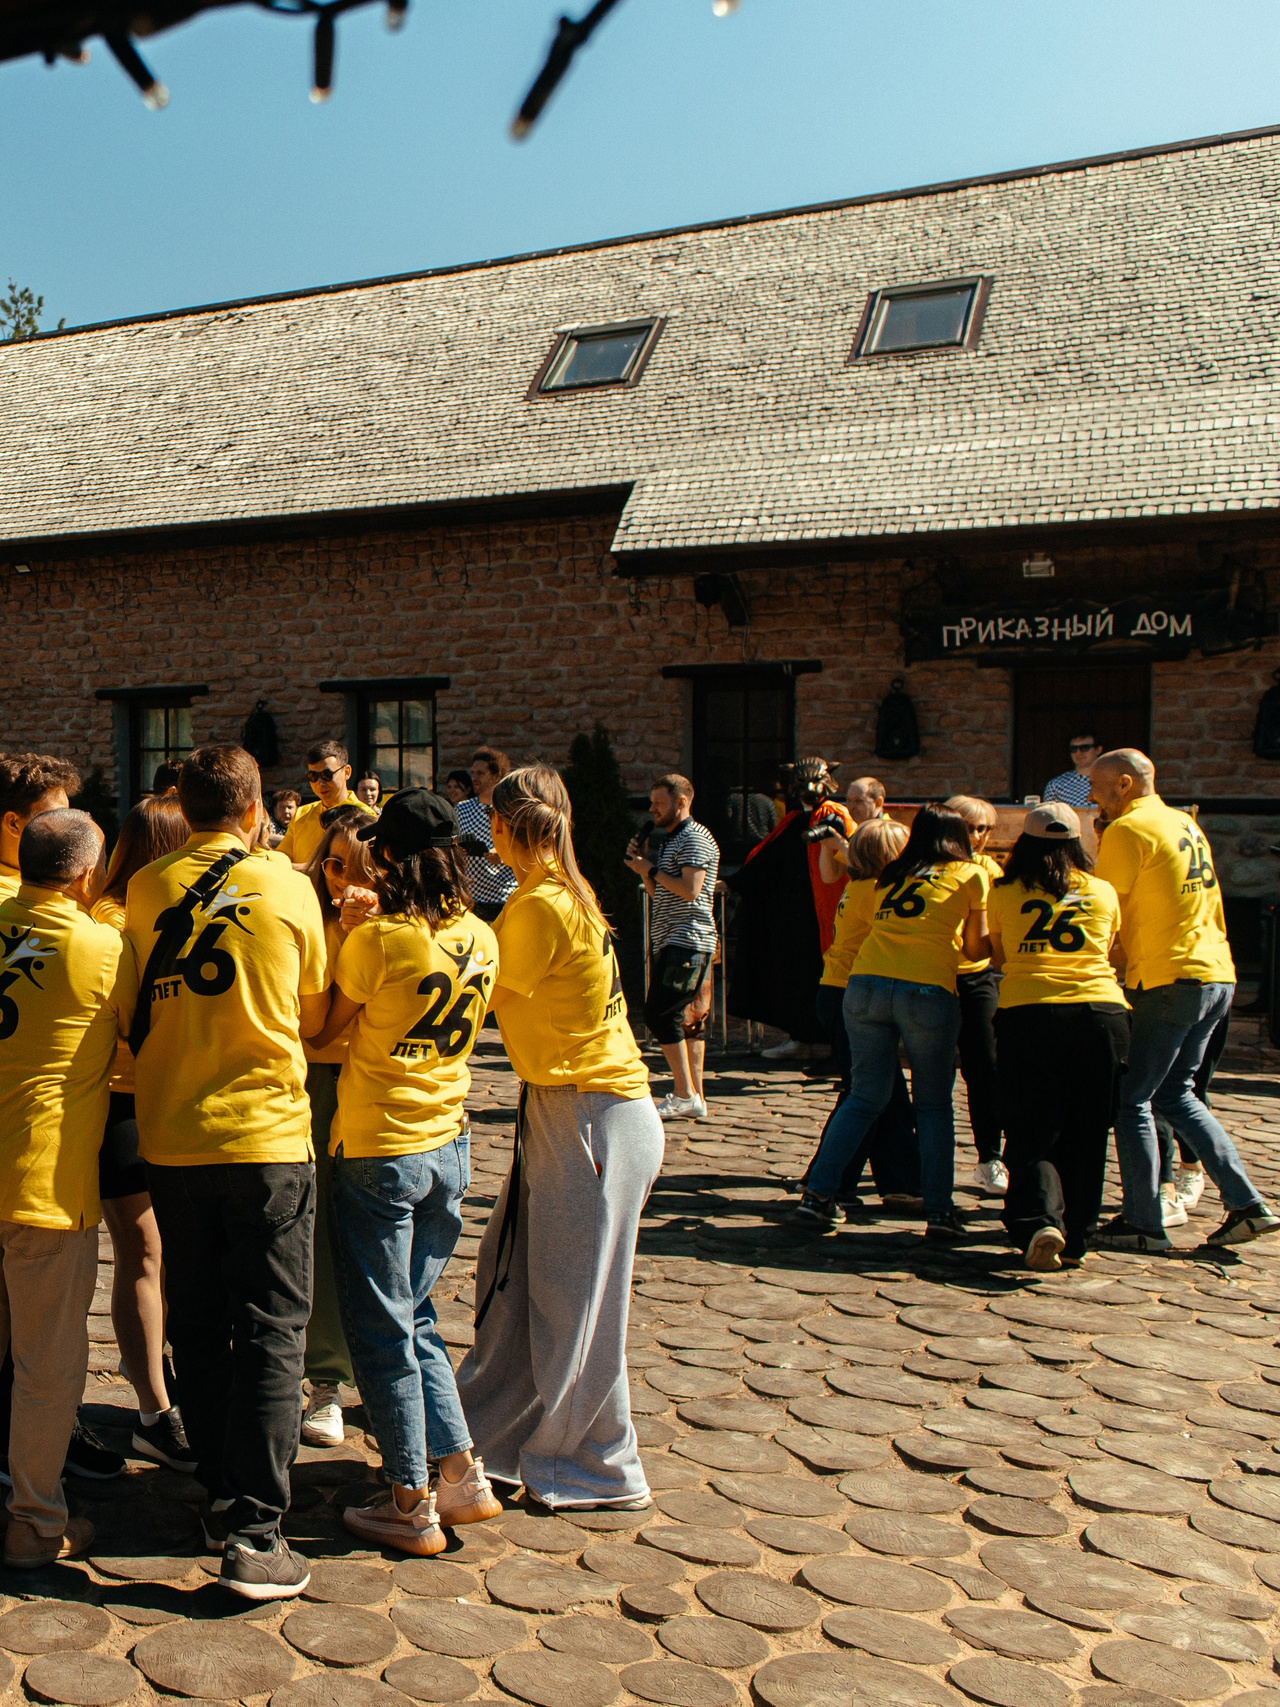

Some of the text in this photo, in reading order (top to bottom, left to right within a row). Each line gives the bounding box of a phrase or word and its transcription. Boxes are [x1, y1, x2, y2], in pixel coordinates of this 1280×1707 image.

[943, 608, 1192, 647] ПРИКАЗНЫЙ ДОМ
[1179, 837, 1217, 888] 26
[1181, 881, 1202, 894] ЛЕТ
[874, 910, 892, 920] ЛЕТ
[1021, 899, 1085, 952] 26
[1018, 942, 1047, 953] ЛЕТ
[151, 980, 182, 1002] ЛЕТ
[404, 971, 472, 1058] 26
[603, 997, 622, 1021] ЛЕТ
[390, 1042, 432, 1059] ЛЕТ
